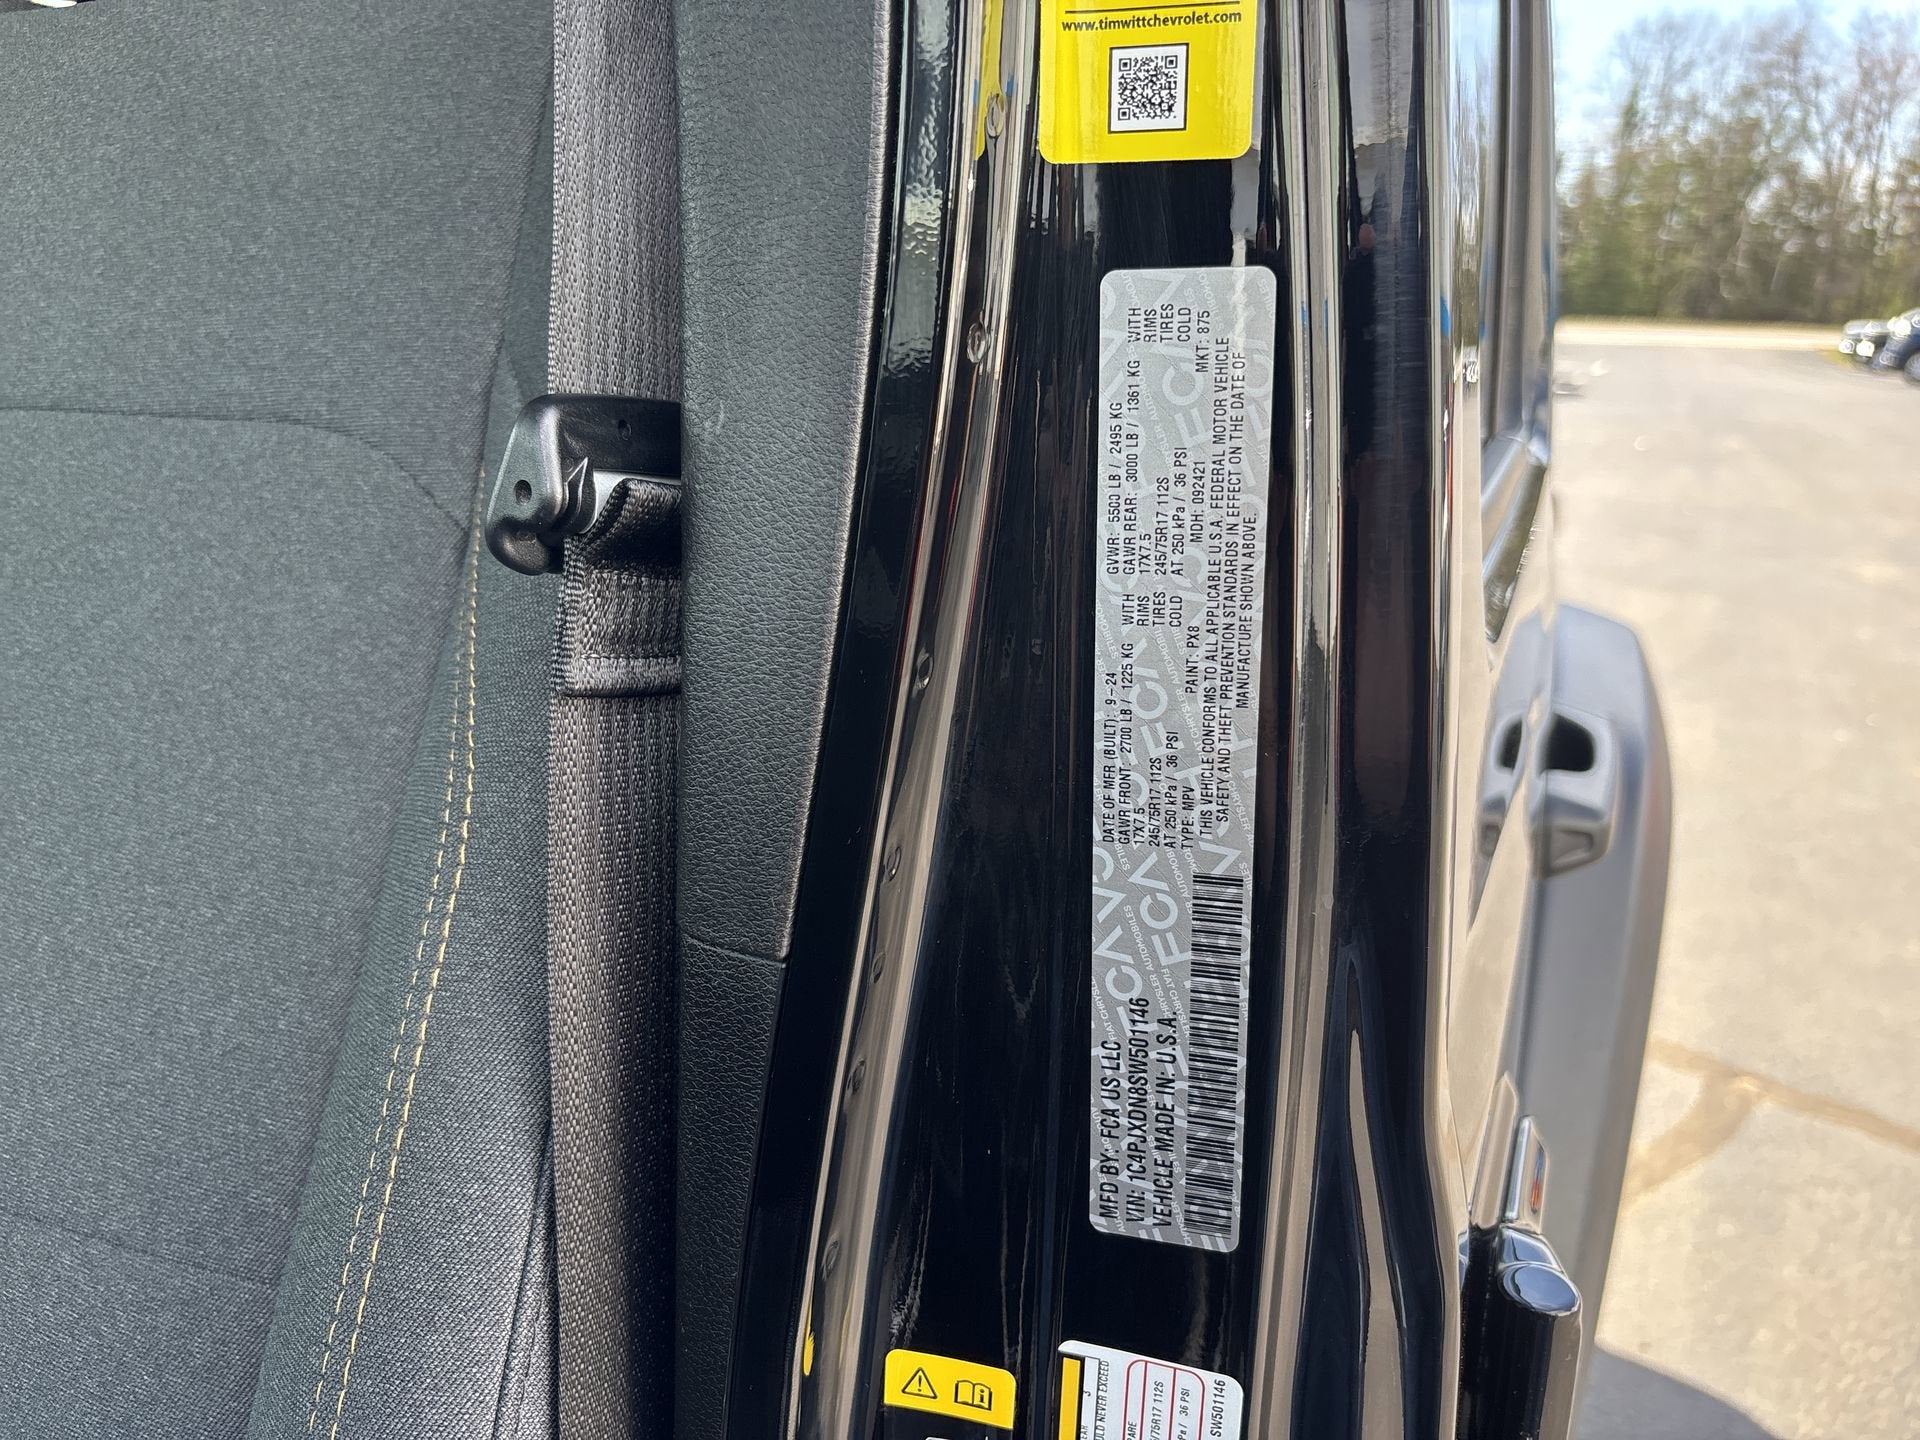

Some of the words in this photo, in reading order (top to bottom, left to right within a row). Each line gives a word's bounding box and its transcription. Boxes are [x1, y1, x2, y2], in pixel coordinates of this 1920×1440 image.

[1062, 11, 1242, 31] www.timwittchevrolet.com
[1128, 307, 1140, 343] WITH
[1144, 309, 1157, 343] RIMS
[1160, 303, 1174, 343] TIRES
[1178, 307, 1191, 342] COLD
[1197, 310, 1210, 334] 875
[1127, 360, 1140, 377] KG
[1196, 339, 1209, 373] MKT:
[1215, 337, 1229, 393] VEHICLE
[1232, 352, 1245, 369] OF
[1127, 383, 1139, 412] 1361
[1231, 374, 1245, 410] DATE
[1110, 402, 1122, 419] KG
[1213, 398, 1227, 444] MOTOR
[1109, 425, 1122, 454] 2495
[1126, 433, 1138, 448] LB
[1230, 415, 1244, 441] THE
[1125, 453, 1138, 483] 3000
[1174, 447, 1187, 467] PSI
[1229, 446, 1242, 464] ON
[1109, 474, 1121, 488] LB
[1157, 477, 1169, 506] 112S
[1174, 473, 1186, 488] 36
[1192, 460, 1205, 504] 092421
[1211, 450, 1226, 509] FEDERAL
[1227, 470, 1241, 517] EFFECT
[1108, 495, 1120, 523] 5500
[1125, 492, 1137, 532] REAR:
[1173, 506, 1185, 529] kPa
[1190, 510, 1204, 543] MDH:
[1210, 515, 1223, 553] U.S.A.
[1226, 523, 1239, 535] IN
[1242, 512, 1256, 559] ABOVE.
[1106, 533, 1119, 574] GVWR:
[1123, 536, 1135, 575] GAWR
[1139, 533, 1151, 574] 17X7.5
[1154, 512, 1168, 575] 245/75R17
[1171, 534, 1185, 556] 250
[1171, 560, 1184, 576] AT
[1223, 541, 1238, 618] STANDARDS
[1206, 559, 1221, 635] APPLICABLE
[1240, 564, 1254, 610] SHOWN
[1122, 593, 1134, 625] WITH
[1137, 596, 1150, 626] RIMS
[1153, 591, 1166, 626] TIRES
[1170, 596, 1182, 627] COLD
[1121, 643, 1133, 659] KG
[1187, 625, 1199, 649] PX8
[1205, 639, 1218, 662] ALL
[1185, 654, 1199, 694] PAINT:
[1204, 666, 1217, 682] TO
[1220, 623, 1235, 699] PREVENTION
[1236, 616, 1252, 708] MANUFACTURE
[1121, 664, 1133, 690] 1225
[1121, 708, 1132, 722] LB
[1202, 686, 1216, 754] CONFORMS
[1219, 706, 1232, 743] THEFT
[1104, 714, 1118, 760] (BUILT):
[1120, 728, 1132, 754] 2700
[1166, 731, 1178, 750] PSI
[1150, 758, 1162, 783] 112S
[1166, 755, 1178, 768] 36
[1218, 748, 1231, 774] AND
[1103, 765, 1116, 790] MFR
[1119, 762, 1131, 805] FRONT:
[1201, 757, 1215, 805] VEHICLE
[1103, 795, 1115, 810] OF
[1165, 785, 1177, 806] kPa
[1182, 786, 1195, 811] MPV
[1216, 777, 1230, 822] SAFETY
[1103, 814, 1115, 843] DATE
[1119, 810, 1131, 845] GAWR
[1134, 808, 1145, 845] 17X7.5
[1149, 788, 1161, 847] 245/75R17
[1165, 810, 1177, 829] 250
[1181, 816, 1194, 849] TYPE:
[1200, 810, 1213, 837] THIS
[1164, 833, 1176, 849] AT
[1157, 1011, 1177, 1064] U.S.A.
[1101, 1040, 1121, 1071] LLC
[1100, 1077, 1120, 1100] US
[1127, 998, 1150, 1182] 1C4PJXDN8SW501146
[1156, 1071, 1175, 1096] IN:
[1100, 1108, 1120, 1139] FCA
[1154, 1103, 1175, 1152] MADE
[1100, 1149, 1119, 1176] BY:
[1100, 1182, 1119, 1219] MFD
[1126, 1190, 1146, 1222] VIN:
[1153, 1159, 1174, 1227] VEHICLE
[1098, 1360, 1109, 1393] EXCEED
[1153, 1381, 1164, 1403] 112S
[1096, 1395, 1107, 1422] NEVER
[1180, 1388, 1190, 1403] PSI
[1180, 1405, 1189, 1416] 36
[1210, 1379, 1226, 1437] SW501146
